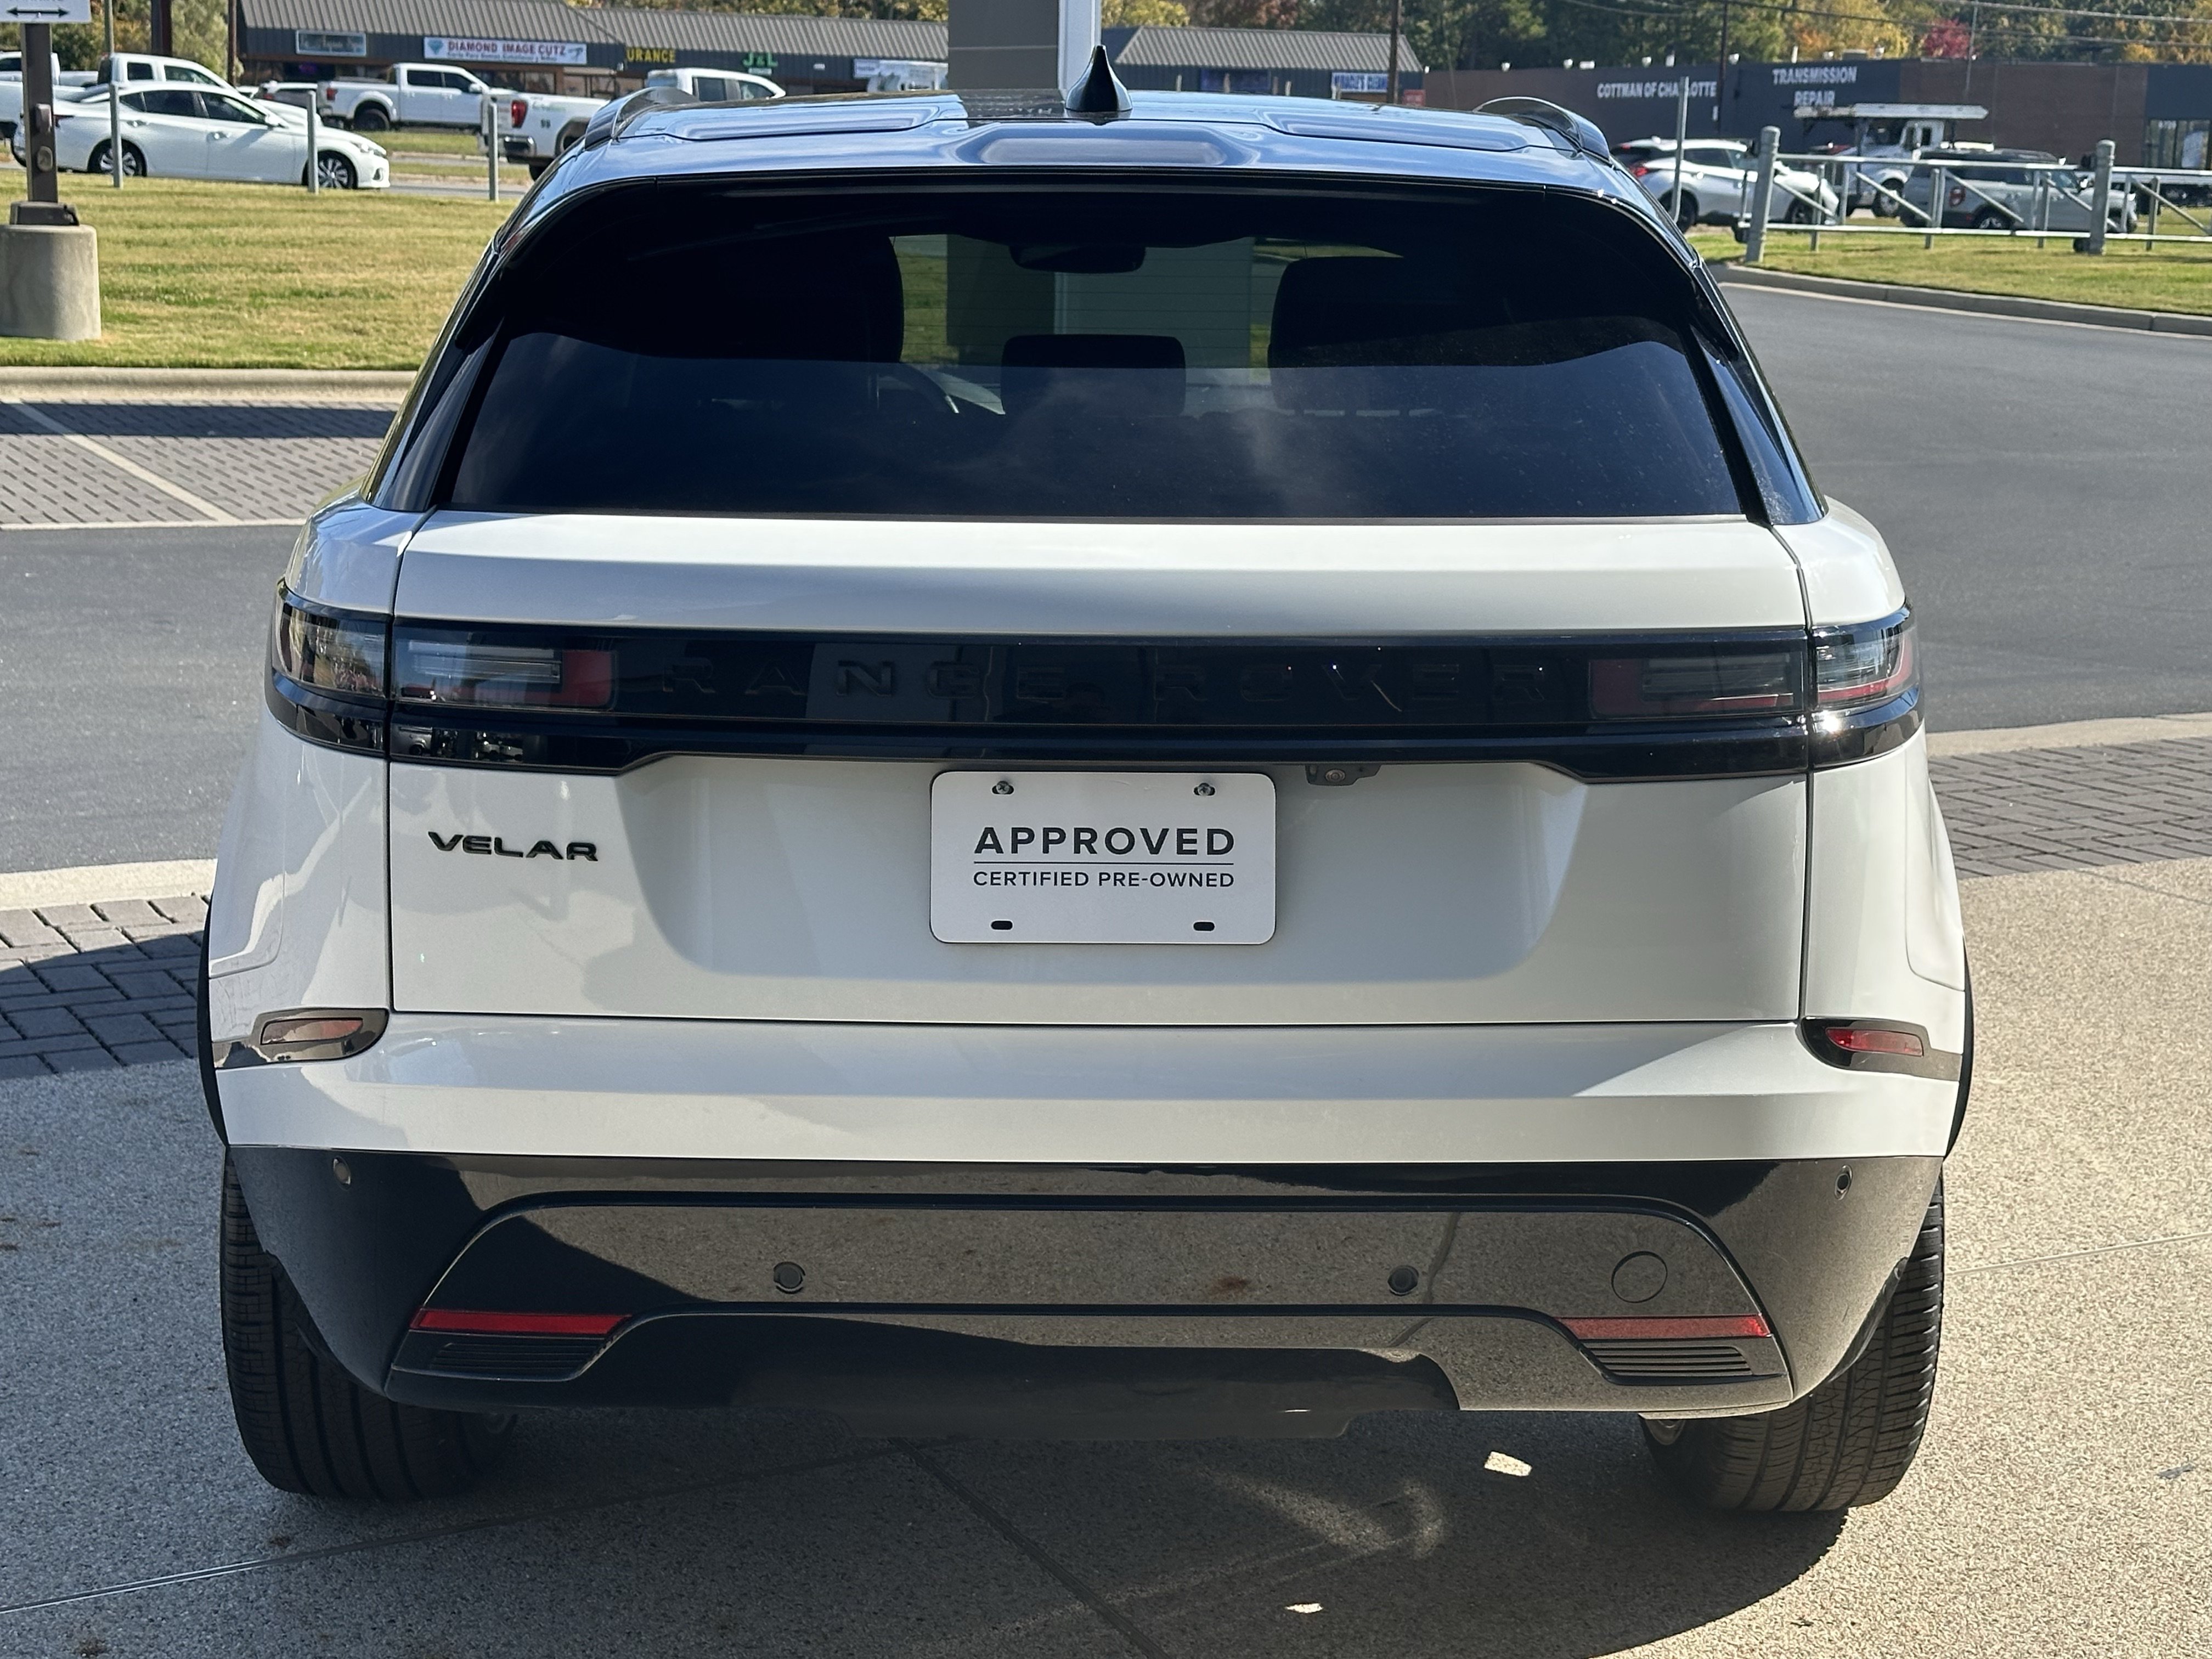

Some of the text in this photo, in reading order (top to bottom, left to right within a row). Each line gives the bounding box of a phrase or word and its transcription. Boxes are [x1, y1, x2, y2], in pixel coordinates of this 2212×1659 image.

[448, 41, 498, 52] DIAMOND
[502, 43, 534, 54] IMAGE
[627, 48, 675, 63] URANCE
[1773, 66, 1857, 85] TRANSMISSION
[1597, 81, 1717, 98] COTTMAN OF CHAOTTE
[1795, 91, 1835, 106] REPAIR
[662, 657, 1064, 700] RANGE
[428, 831, 598, 861] VELAR
[974, 826, 1235, 855] APPROVED
[973, 871, 1234, 888] CERTIFIED PRE-OWNED
